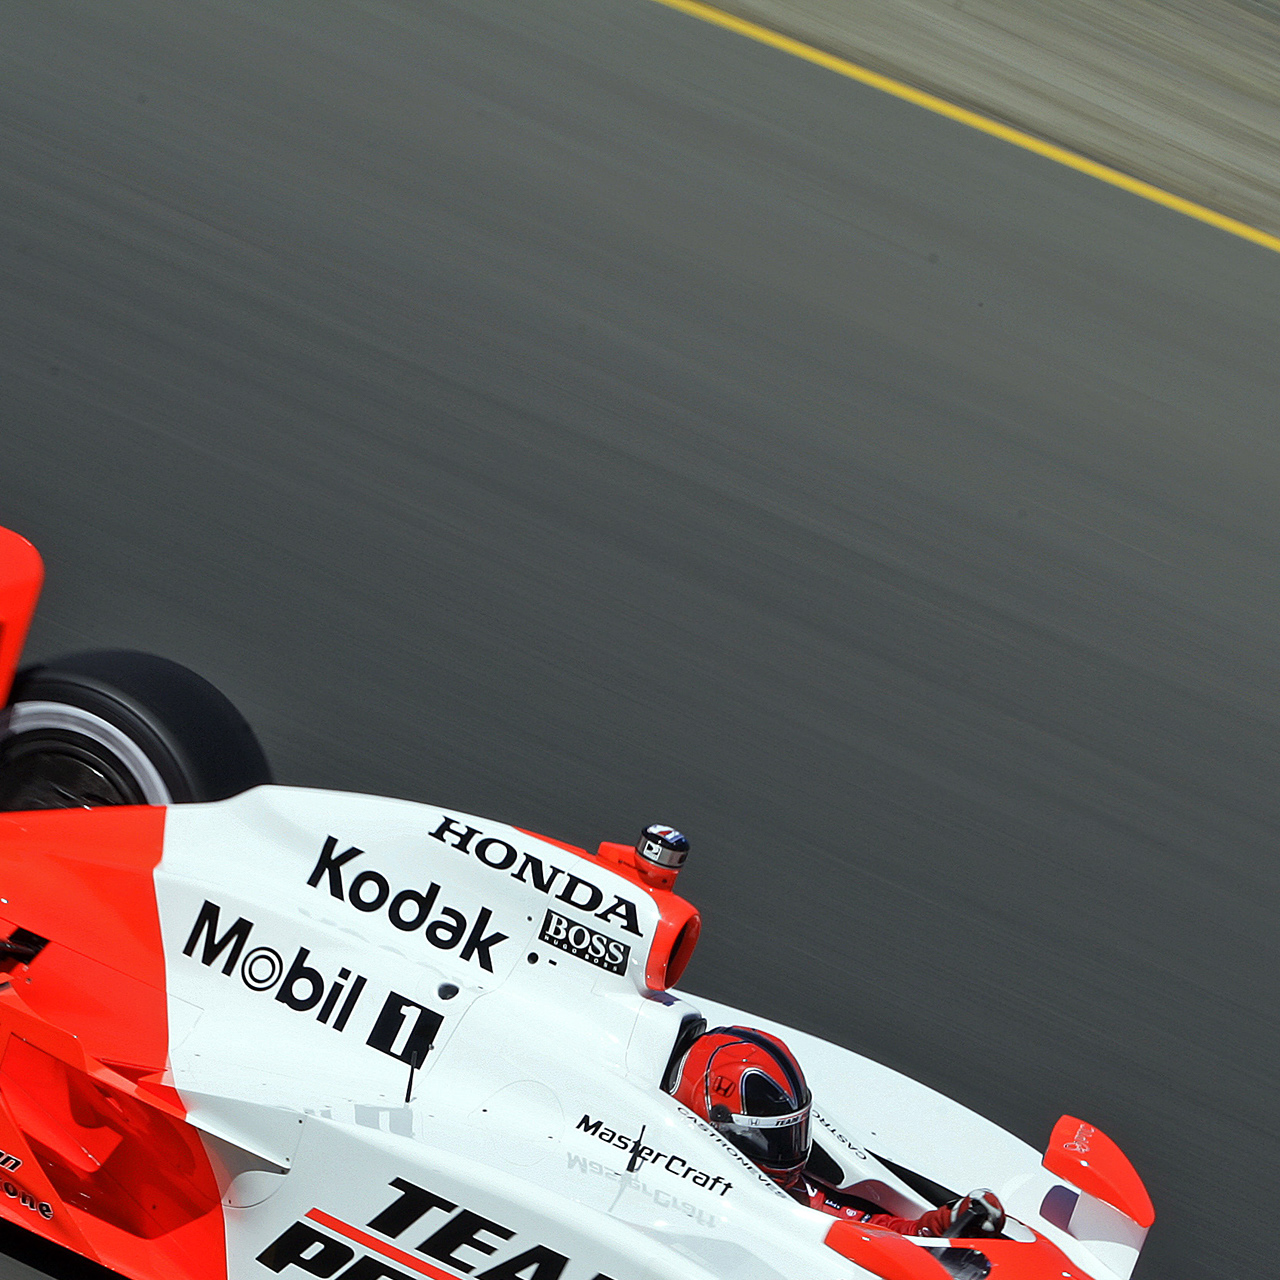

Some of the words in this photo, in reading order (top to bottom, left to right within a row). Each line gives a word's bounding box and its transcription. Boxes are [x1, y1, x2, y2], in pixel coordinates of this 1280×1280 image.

[307, 836, 508, 973] Kodak
[429, 816, 643, 937] HONDA
[182, 900, 367, 1032] Mobil
[544, 934, 577, 954] HUGO
[584, 953, 618, 972] BOSS
[545, 913, 625, 964] BOSS
[575, 1114, 734, 1197] MasterCraft
